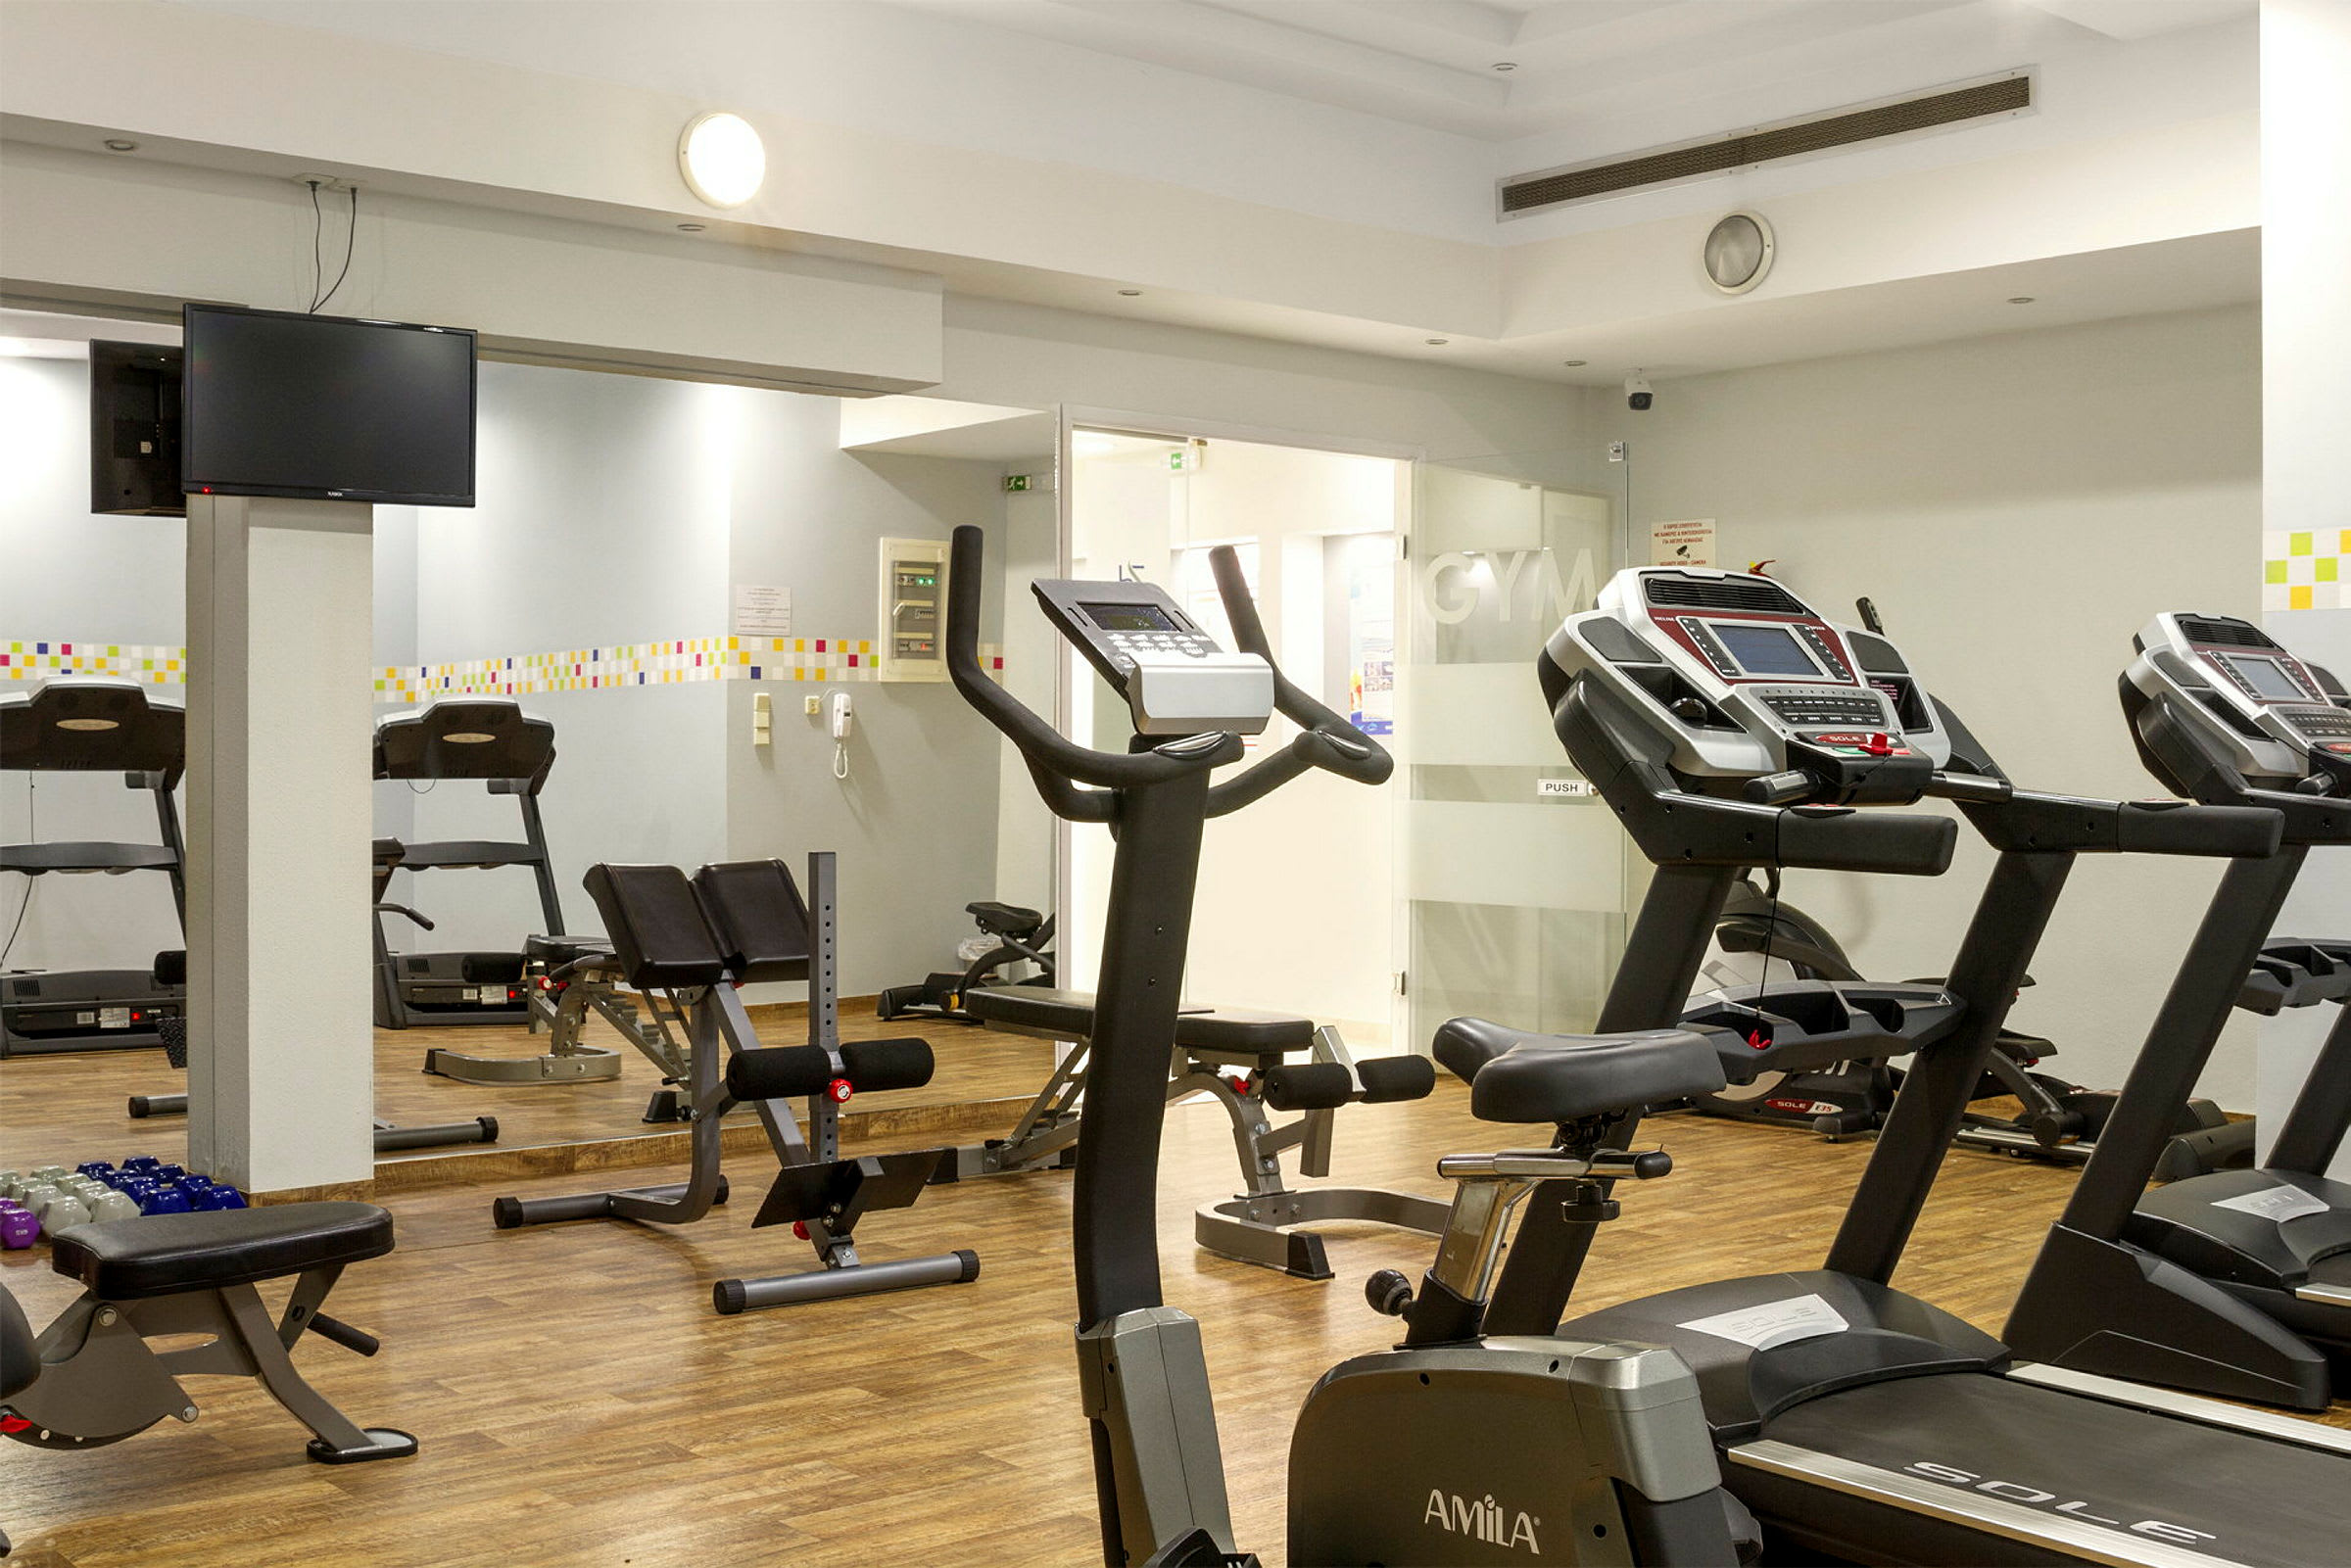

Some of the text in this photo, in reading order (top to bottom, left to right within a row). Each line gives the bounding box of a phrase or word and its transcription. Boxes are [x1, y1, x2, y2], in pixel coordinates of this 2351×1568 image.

[1423, 547, 1598, 625] GYM
[1545, 783, 1579, 792] PUSH
[1903, 1461, 2217, 1544] SOLE
